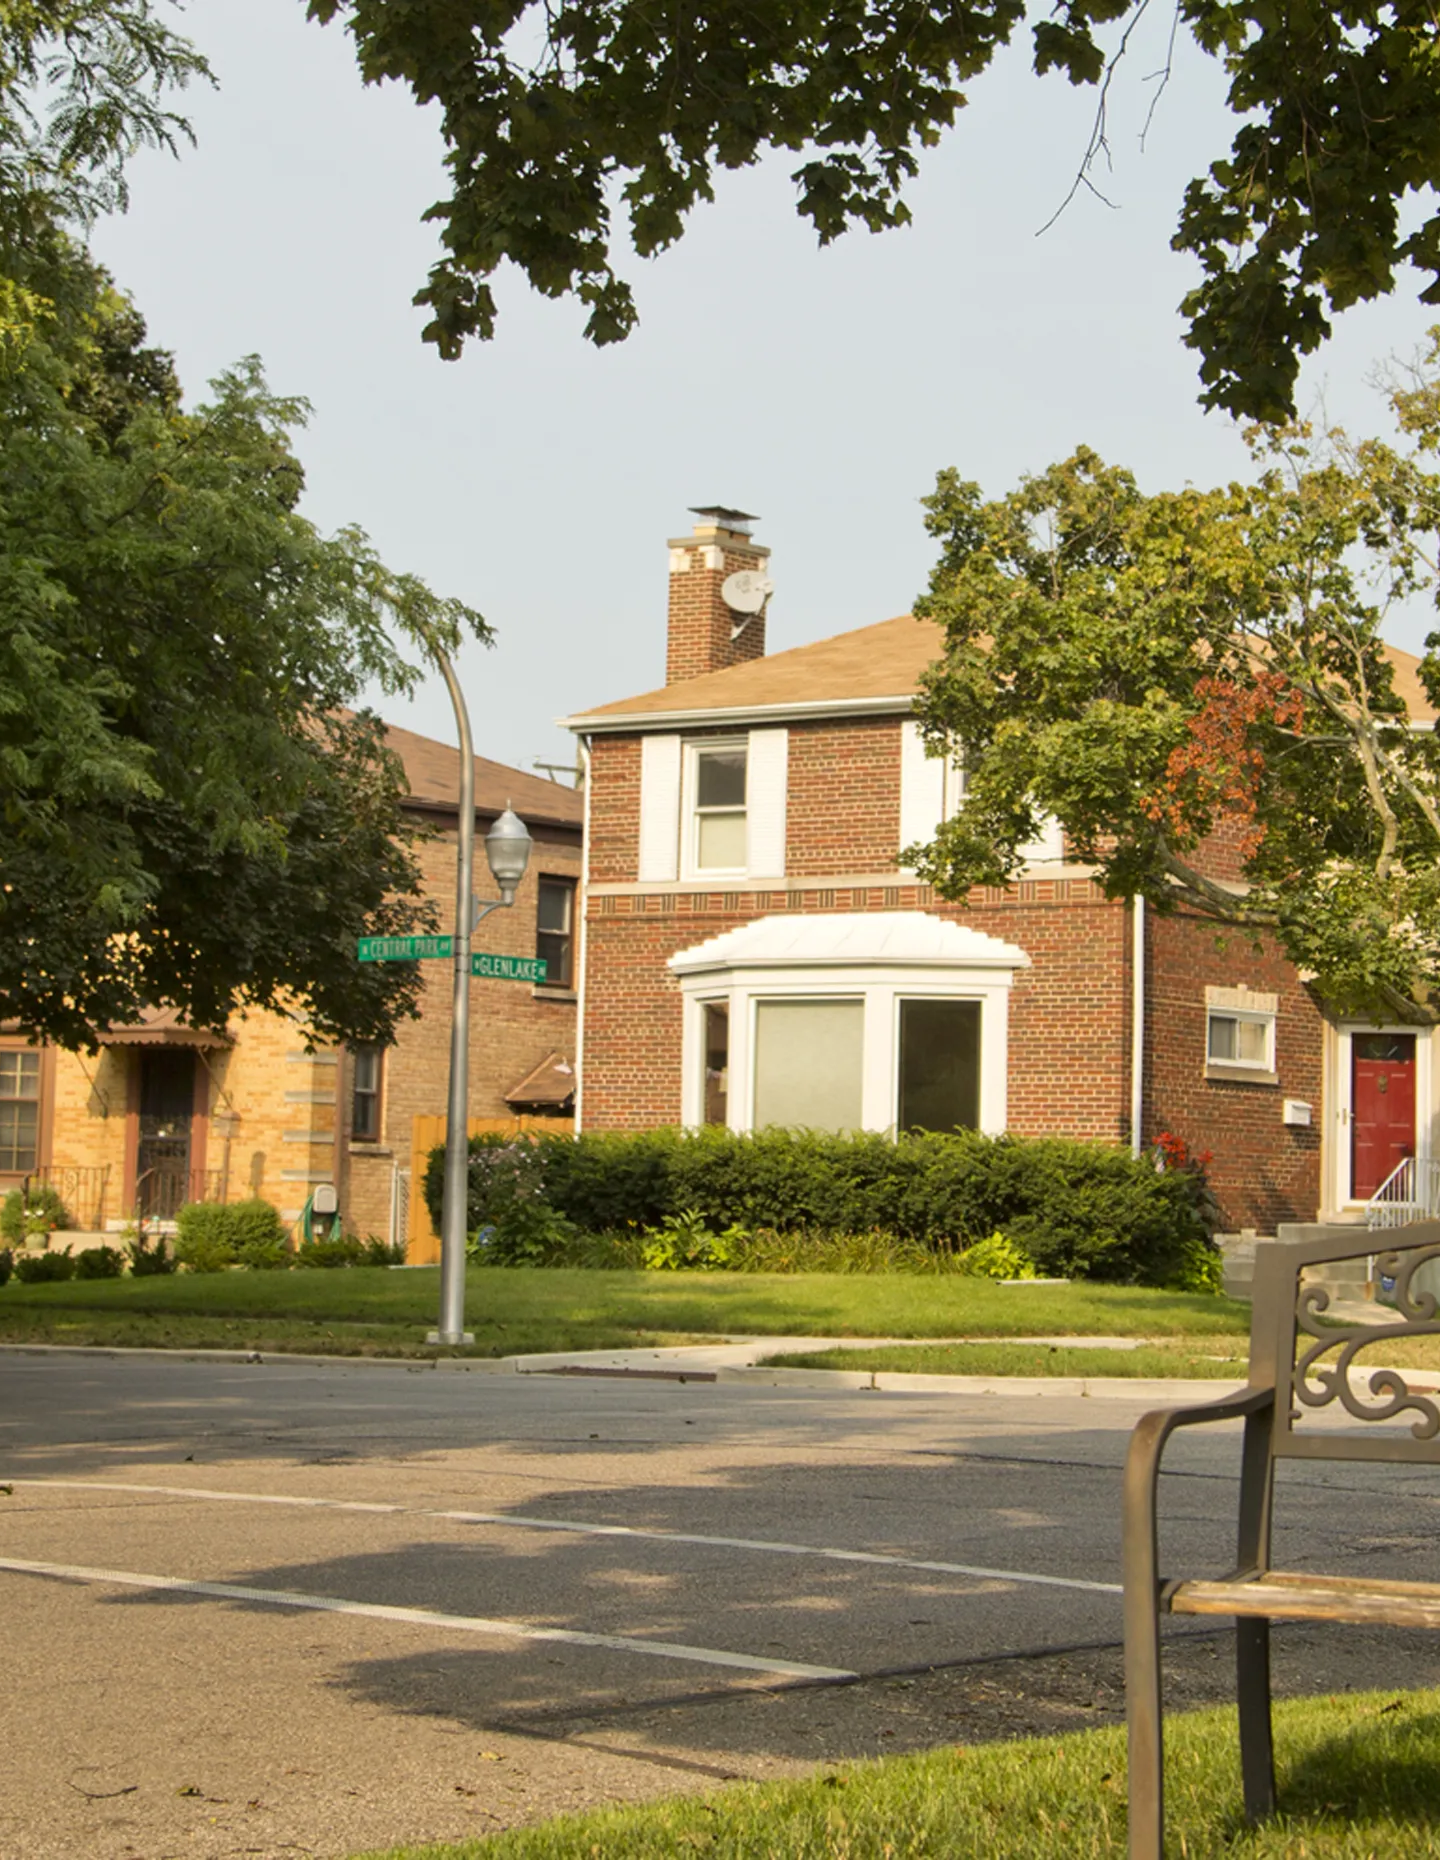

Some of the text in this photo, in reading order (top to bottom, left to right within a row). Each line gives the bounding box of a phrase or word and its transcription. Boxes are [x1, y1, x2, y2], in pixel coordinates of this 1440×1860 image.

[370, 940, 412, 958] CENTRAL
[415, 939, 439, 956] PARK
[479, 956, 538, 980] GLENLAKE
